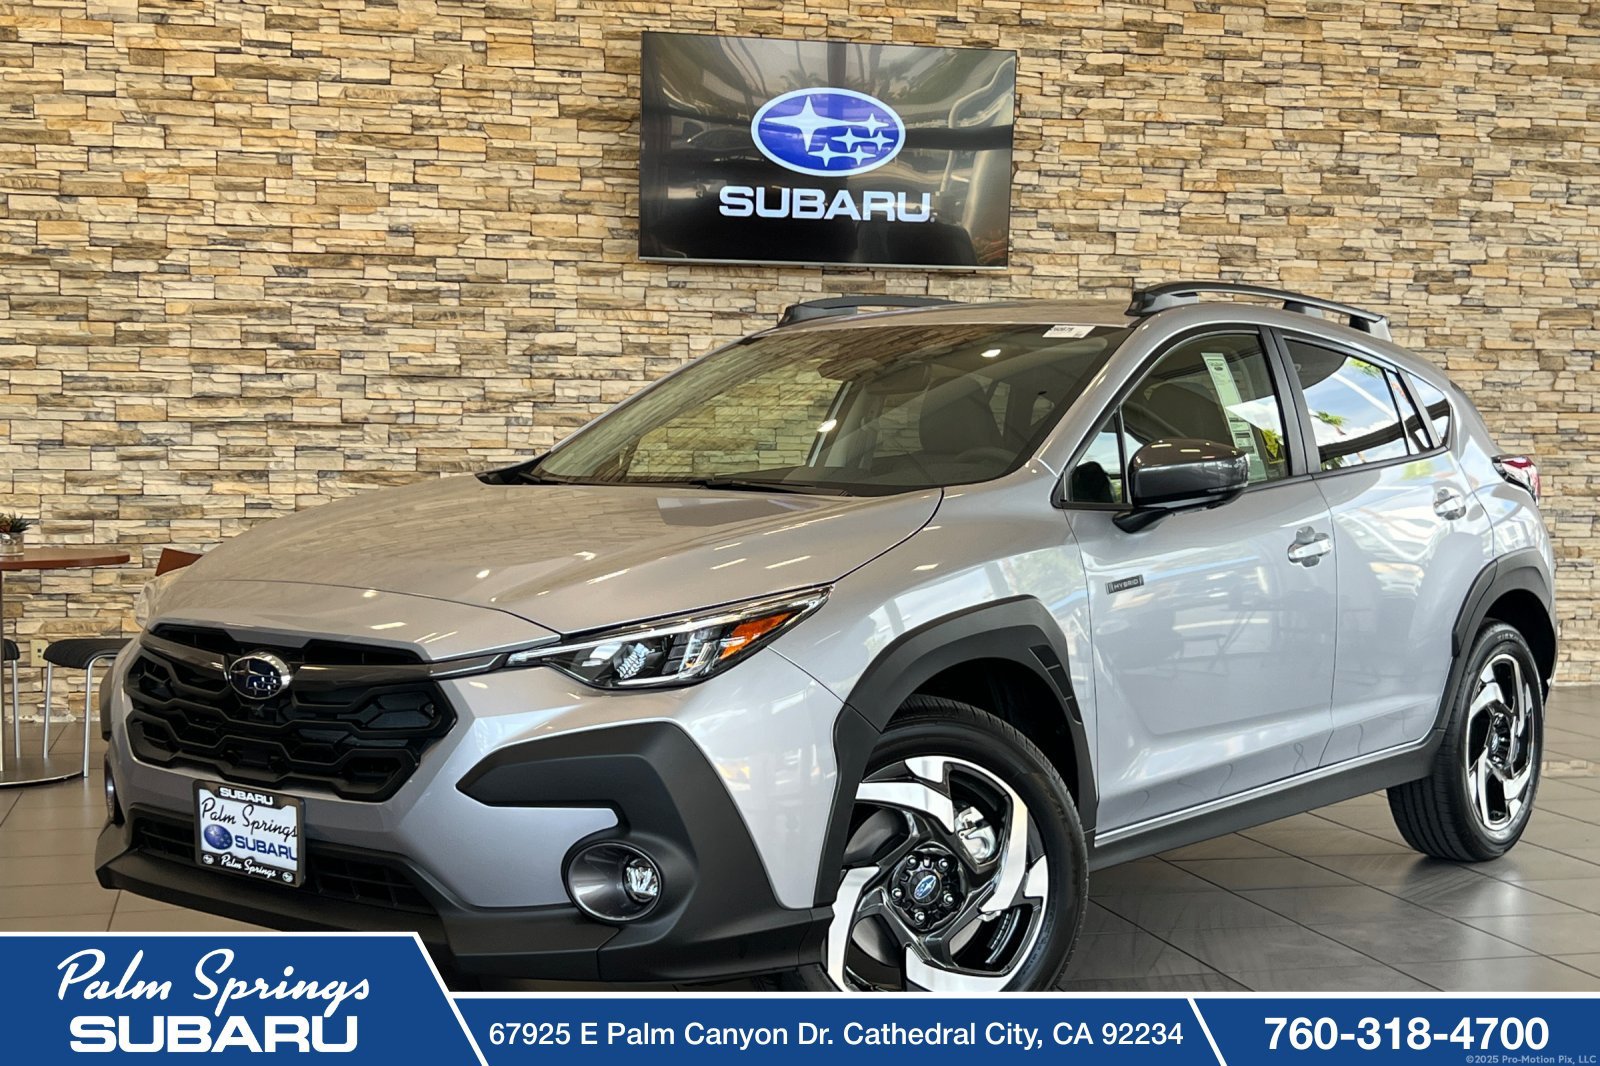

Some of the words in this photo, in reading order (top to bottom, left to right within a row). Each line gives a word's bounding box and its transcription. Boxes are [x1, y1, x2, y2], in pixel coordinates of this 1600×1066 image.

[719, 185, 932, 223] SUBARU
[1113, 578, 1139, 590] HYBRID
[219, 787, 274, 806] SUBARU
[201, 797, 236, 825] Palm
[242, 804, 298, 843] Springs
[221, 854, 242, 870] Palm
[244, 858, 277, 879] Springs
